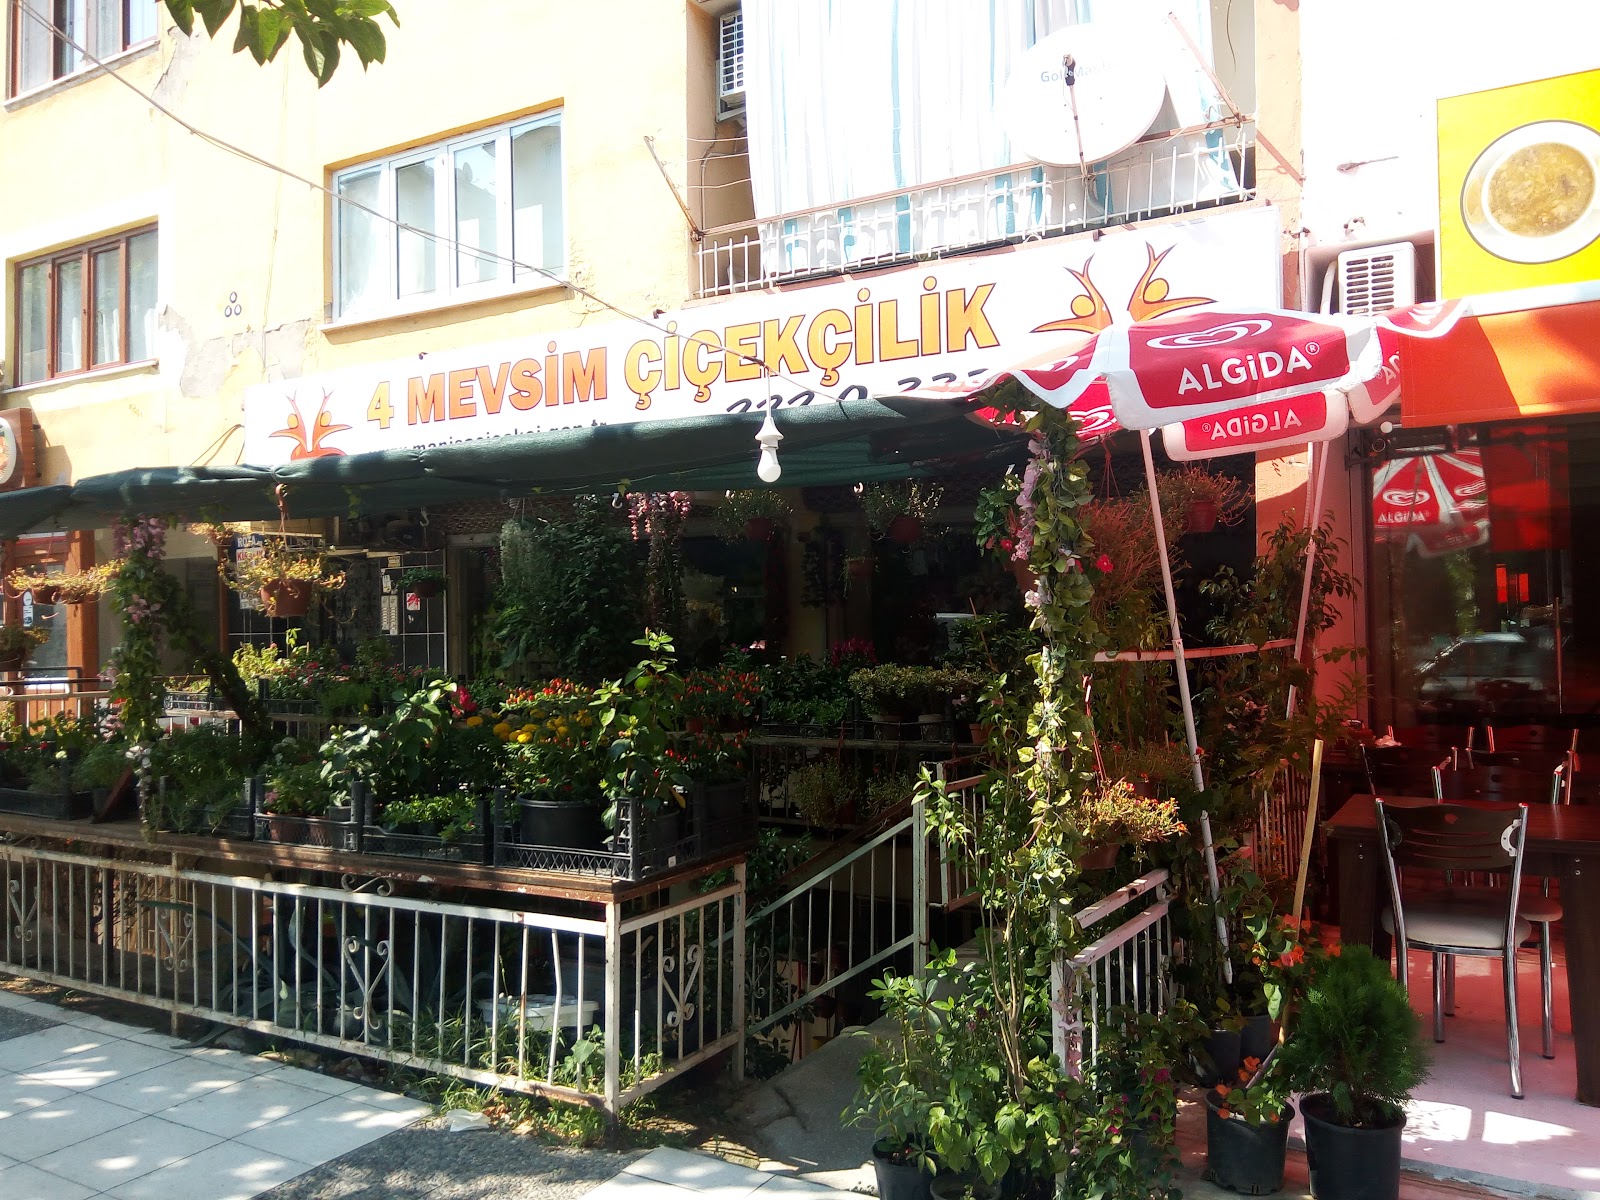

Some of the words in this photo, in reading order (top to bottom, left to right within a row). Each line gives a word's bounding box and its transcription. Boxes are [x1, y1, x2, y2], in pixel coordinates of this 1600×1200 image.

[366, 380, 395, 430] 4
[407, 340, 608, 426] MEVSİM
[623, 275, 1001, 411] ÇİÇEKÇİLİK
